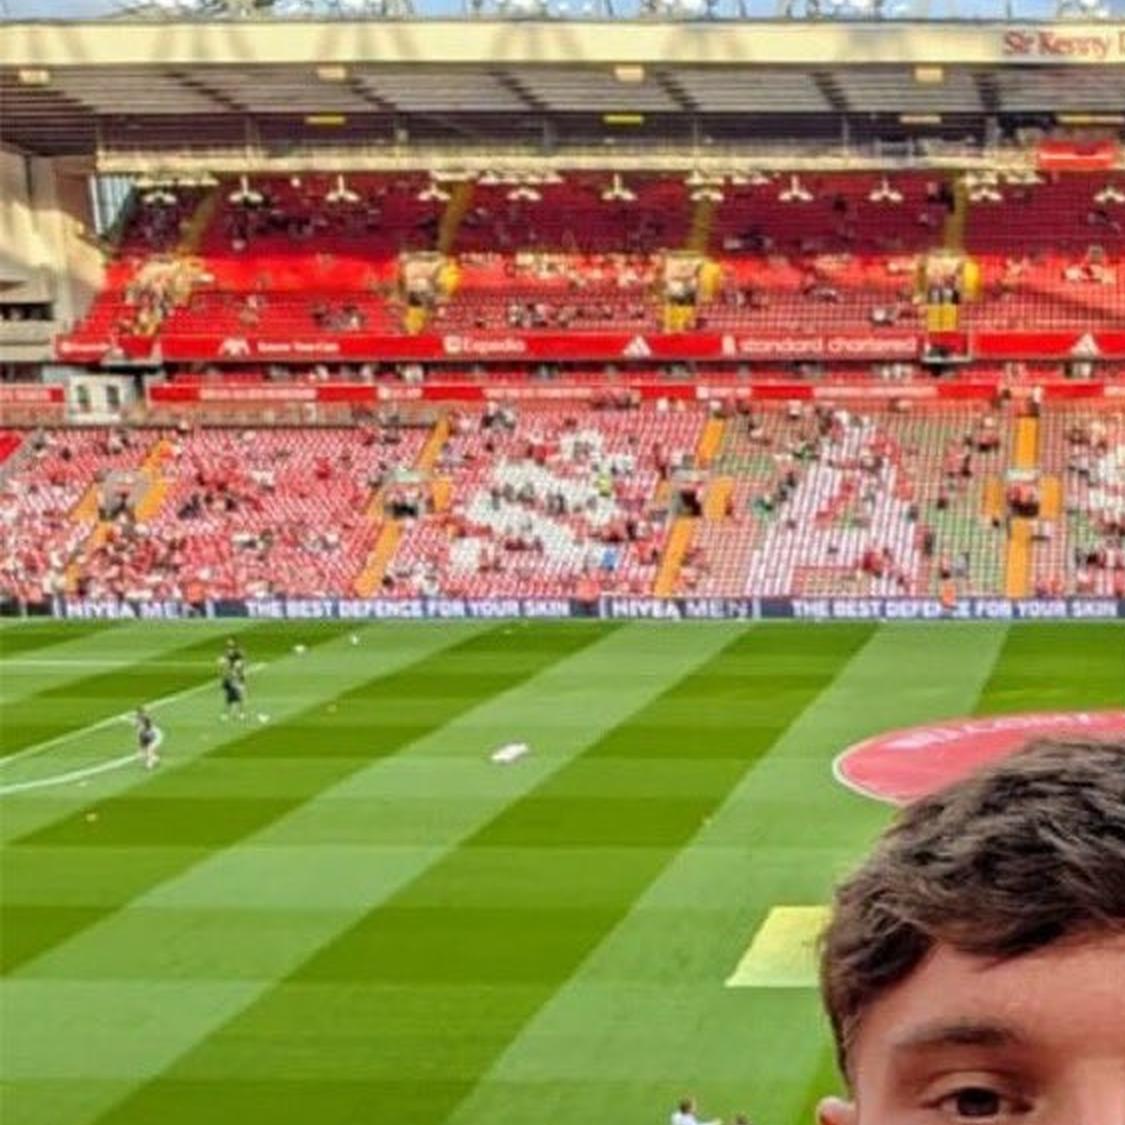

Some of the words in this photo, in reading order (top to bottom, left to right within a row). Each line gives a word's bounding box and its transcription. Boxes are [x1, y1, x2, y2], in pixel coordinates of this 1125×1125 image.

[1037, 31, 1111, 57] Kenny
[247, 600, 284, 617] THE
[286, 600, 333, 617] BEST
[339, 600, 423, 617] DEFENCE
[427, 600, 466, 617] FOR
[469, 600, 520, 617] YOUR
[523, 600, 570, 617] SKIN
[793, 600, 830, 618] THE
[832, 600, 882, 618] BEST
[1016, 600, 1066, 618] YOUR
[1070, 600, 1118, 618] SKIN
